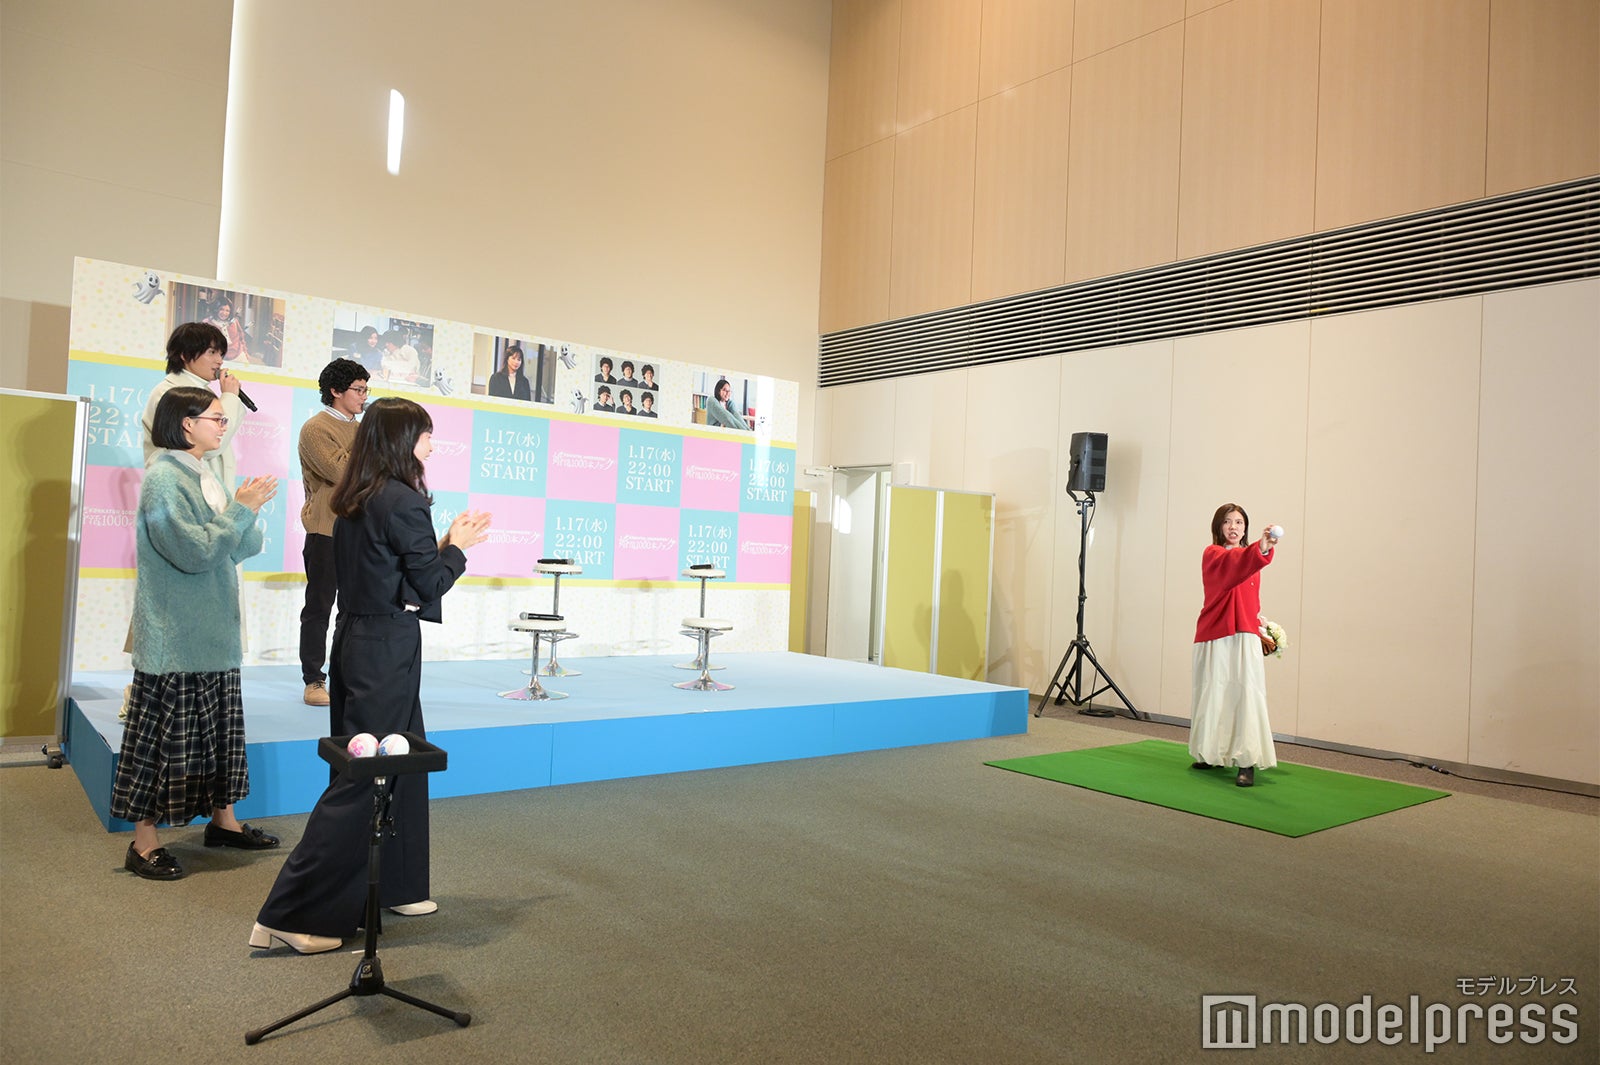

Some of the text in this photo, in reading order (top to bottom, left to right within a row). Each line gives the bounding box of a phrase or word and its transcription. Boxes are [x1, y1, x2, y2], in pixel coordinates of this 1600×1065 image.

[88, 384, 144, 407] 1.17(
[89, 405, 142, 428] 22:0
[87, 426, 143, 448] STA
[484, 429, 541, 448] 1.17(水)
[484, 446, 535, 465] 22:00
[628, 445, 676, 463] 1.17(水)
[480, 462, 538, 481] START
[628, 461, 671, 478] 22:00
[625, 475, 674, 493] START
[749, 473, 785, 489] 22:00
[746, 487, 788, 502] START
[555, 517, 608, 533] 1.17(水)
[688, 524, 732, 540] 1.17(水)
[555, 533, 603, 549] 22:00
[688, 540, 728, 554] 22:00
[552, 549, 605, 566] START
[686, 554, 730, 569] START
